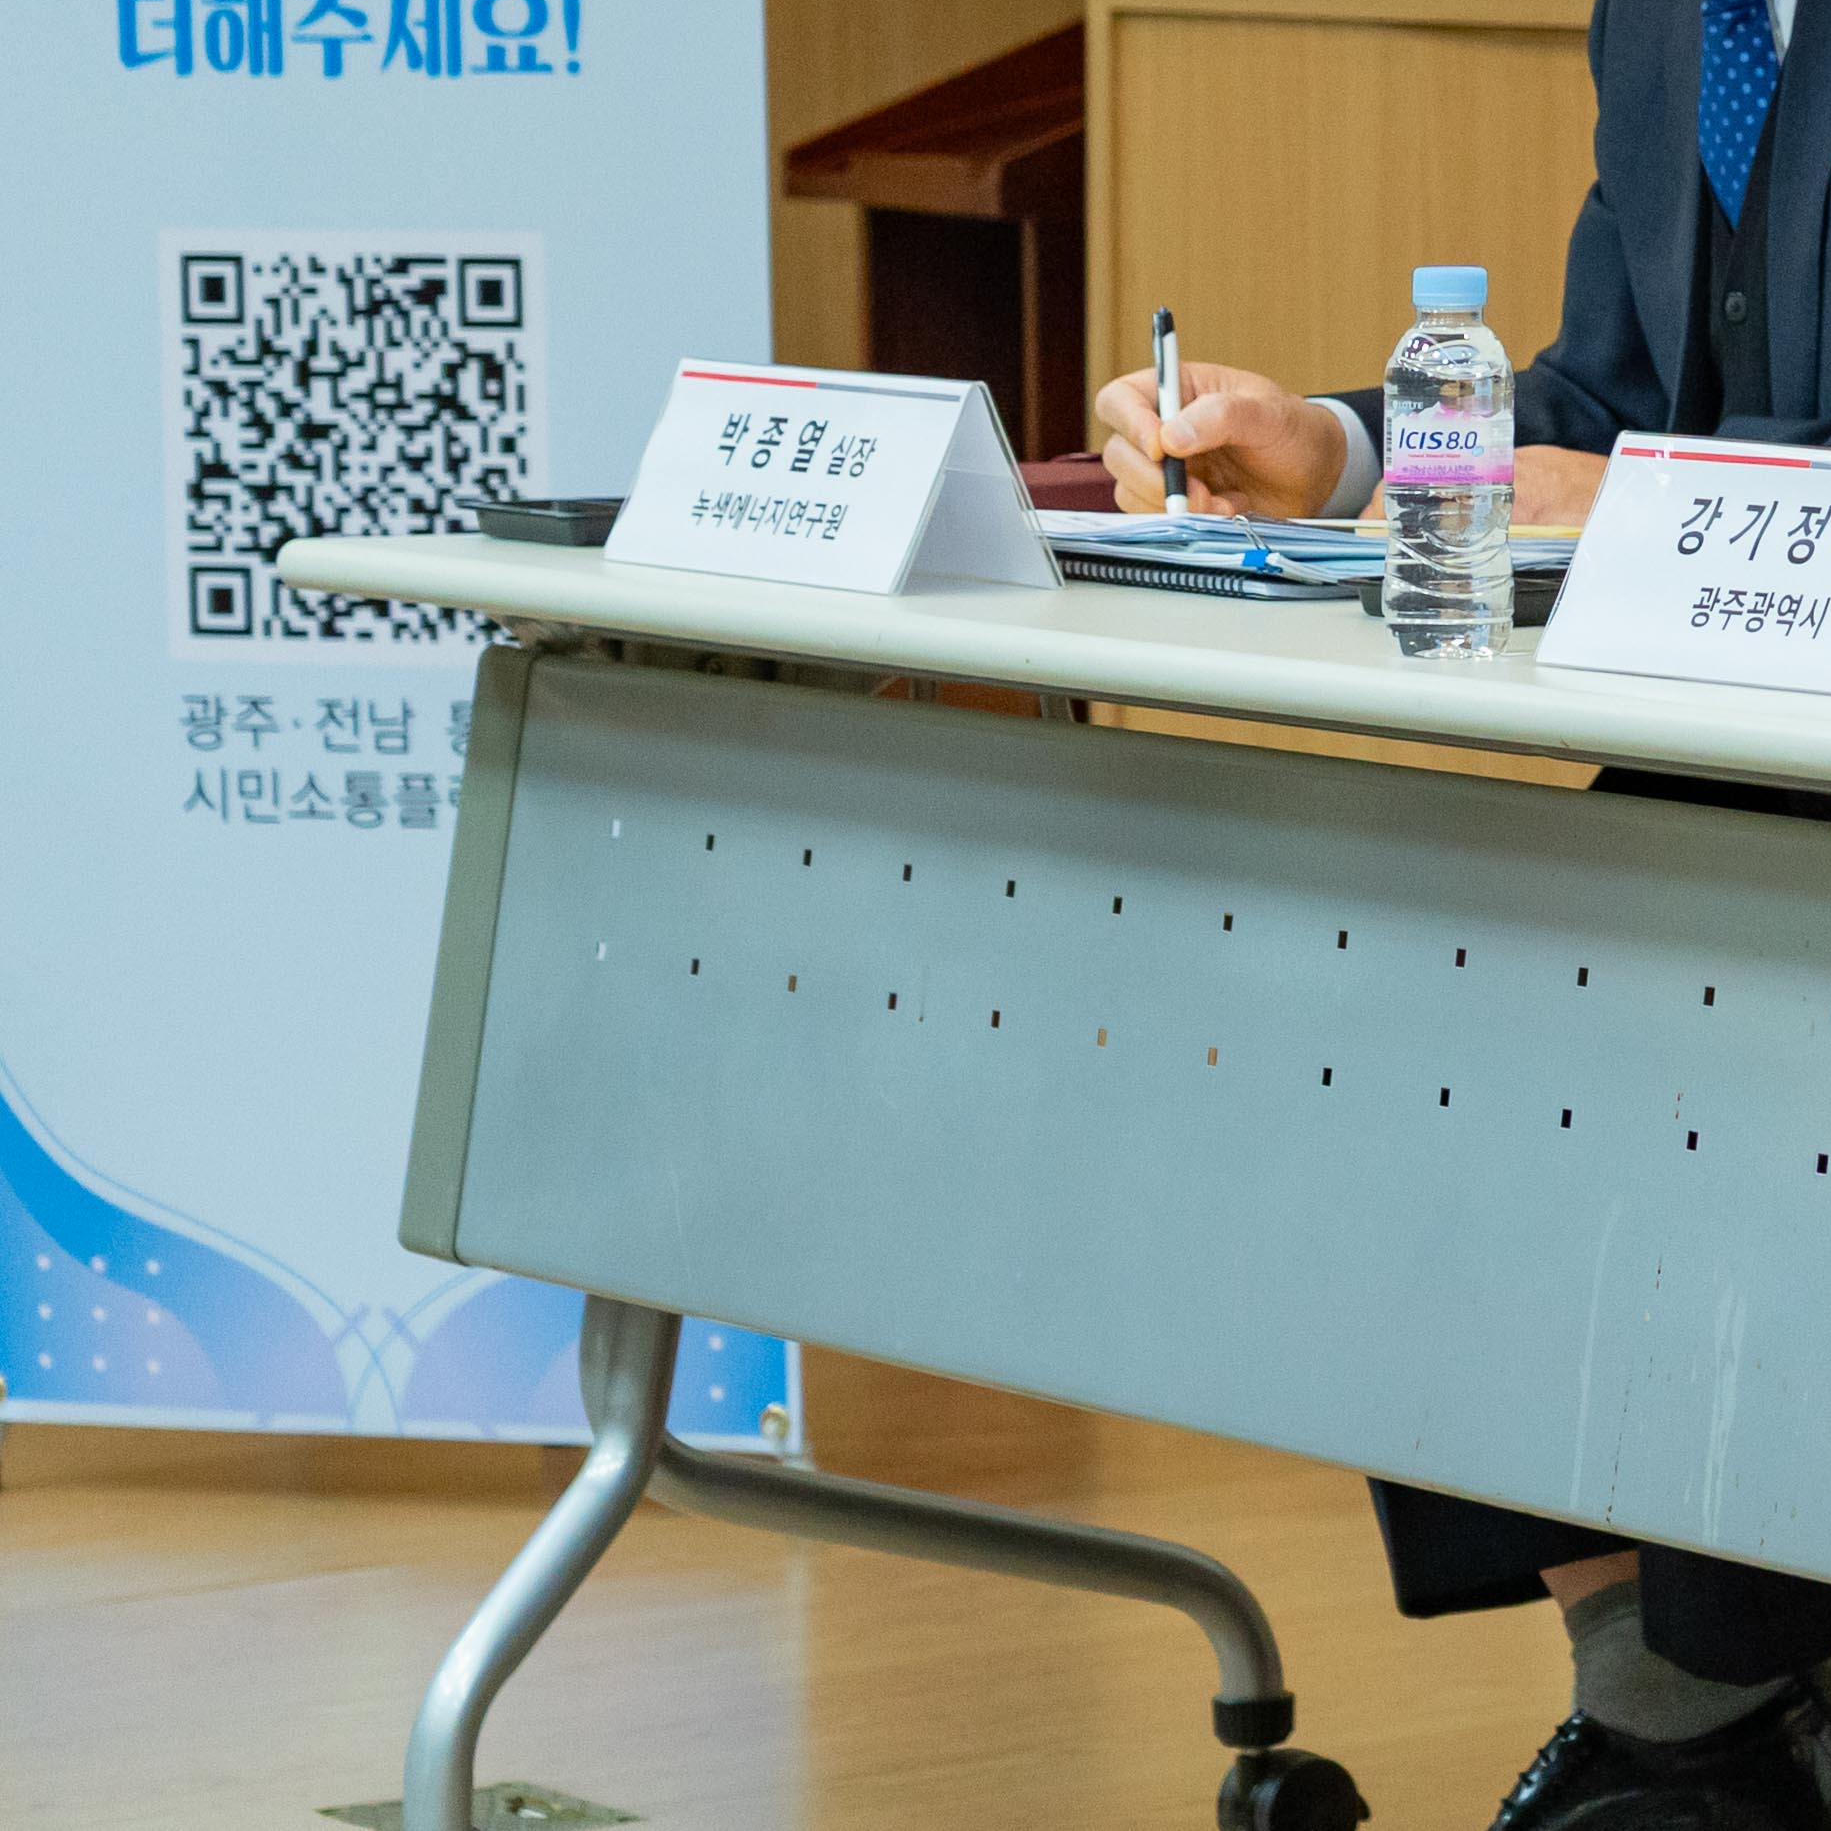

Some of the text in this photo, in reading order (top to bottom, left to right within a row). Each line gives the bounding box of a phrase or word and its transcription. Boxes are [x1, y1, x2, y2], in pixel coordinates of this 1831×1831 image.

[826, 435, 878, 478] 실장
[1446, 430, 1479, 450] 8.0
[691, 489, 848, 541] 녹색에너지연구원
[1690, 586, 1831, 640] 광주광역시
[180, 694, 415, 756] 광주·전남
[183, 767, 462, 829] 시민소통플
